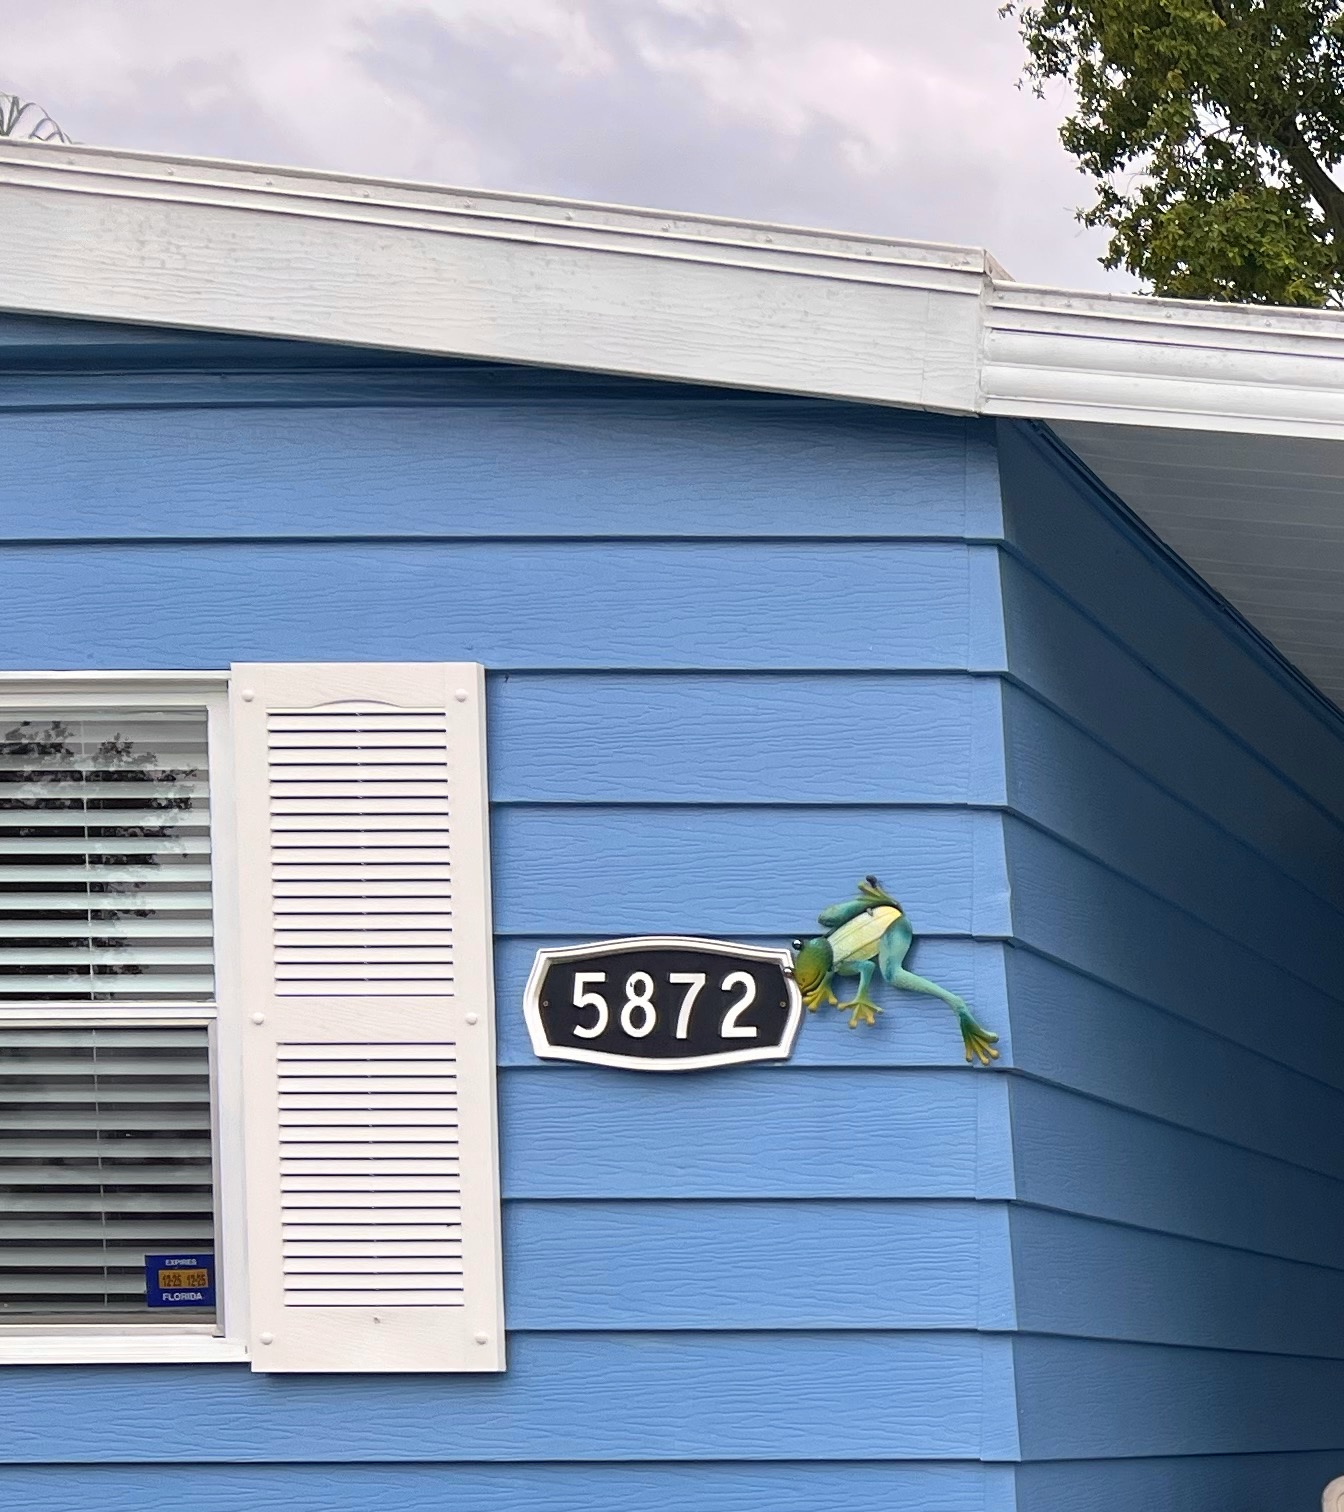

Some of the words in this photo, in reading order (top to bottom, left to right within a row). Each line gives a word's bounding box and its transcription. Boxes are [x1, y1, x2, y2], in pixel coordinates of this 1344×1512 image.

[572, 970, 758, 1040] 5872
[165, 1258, 197, 1266] EXPIRES
[162, 1292, 202, 1301] FLORIDA
